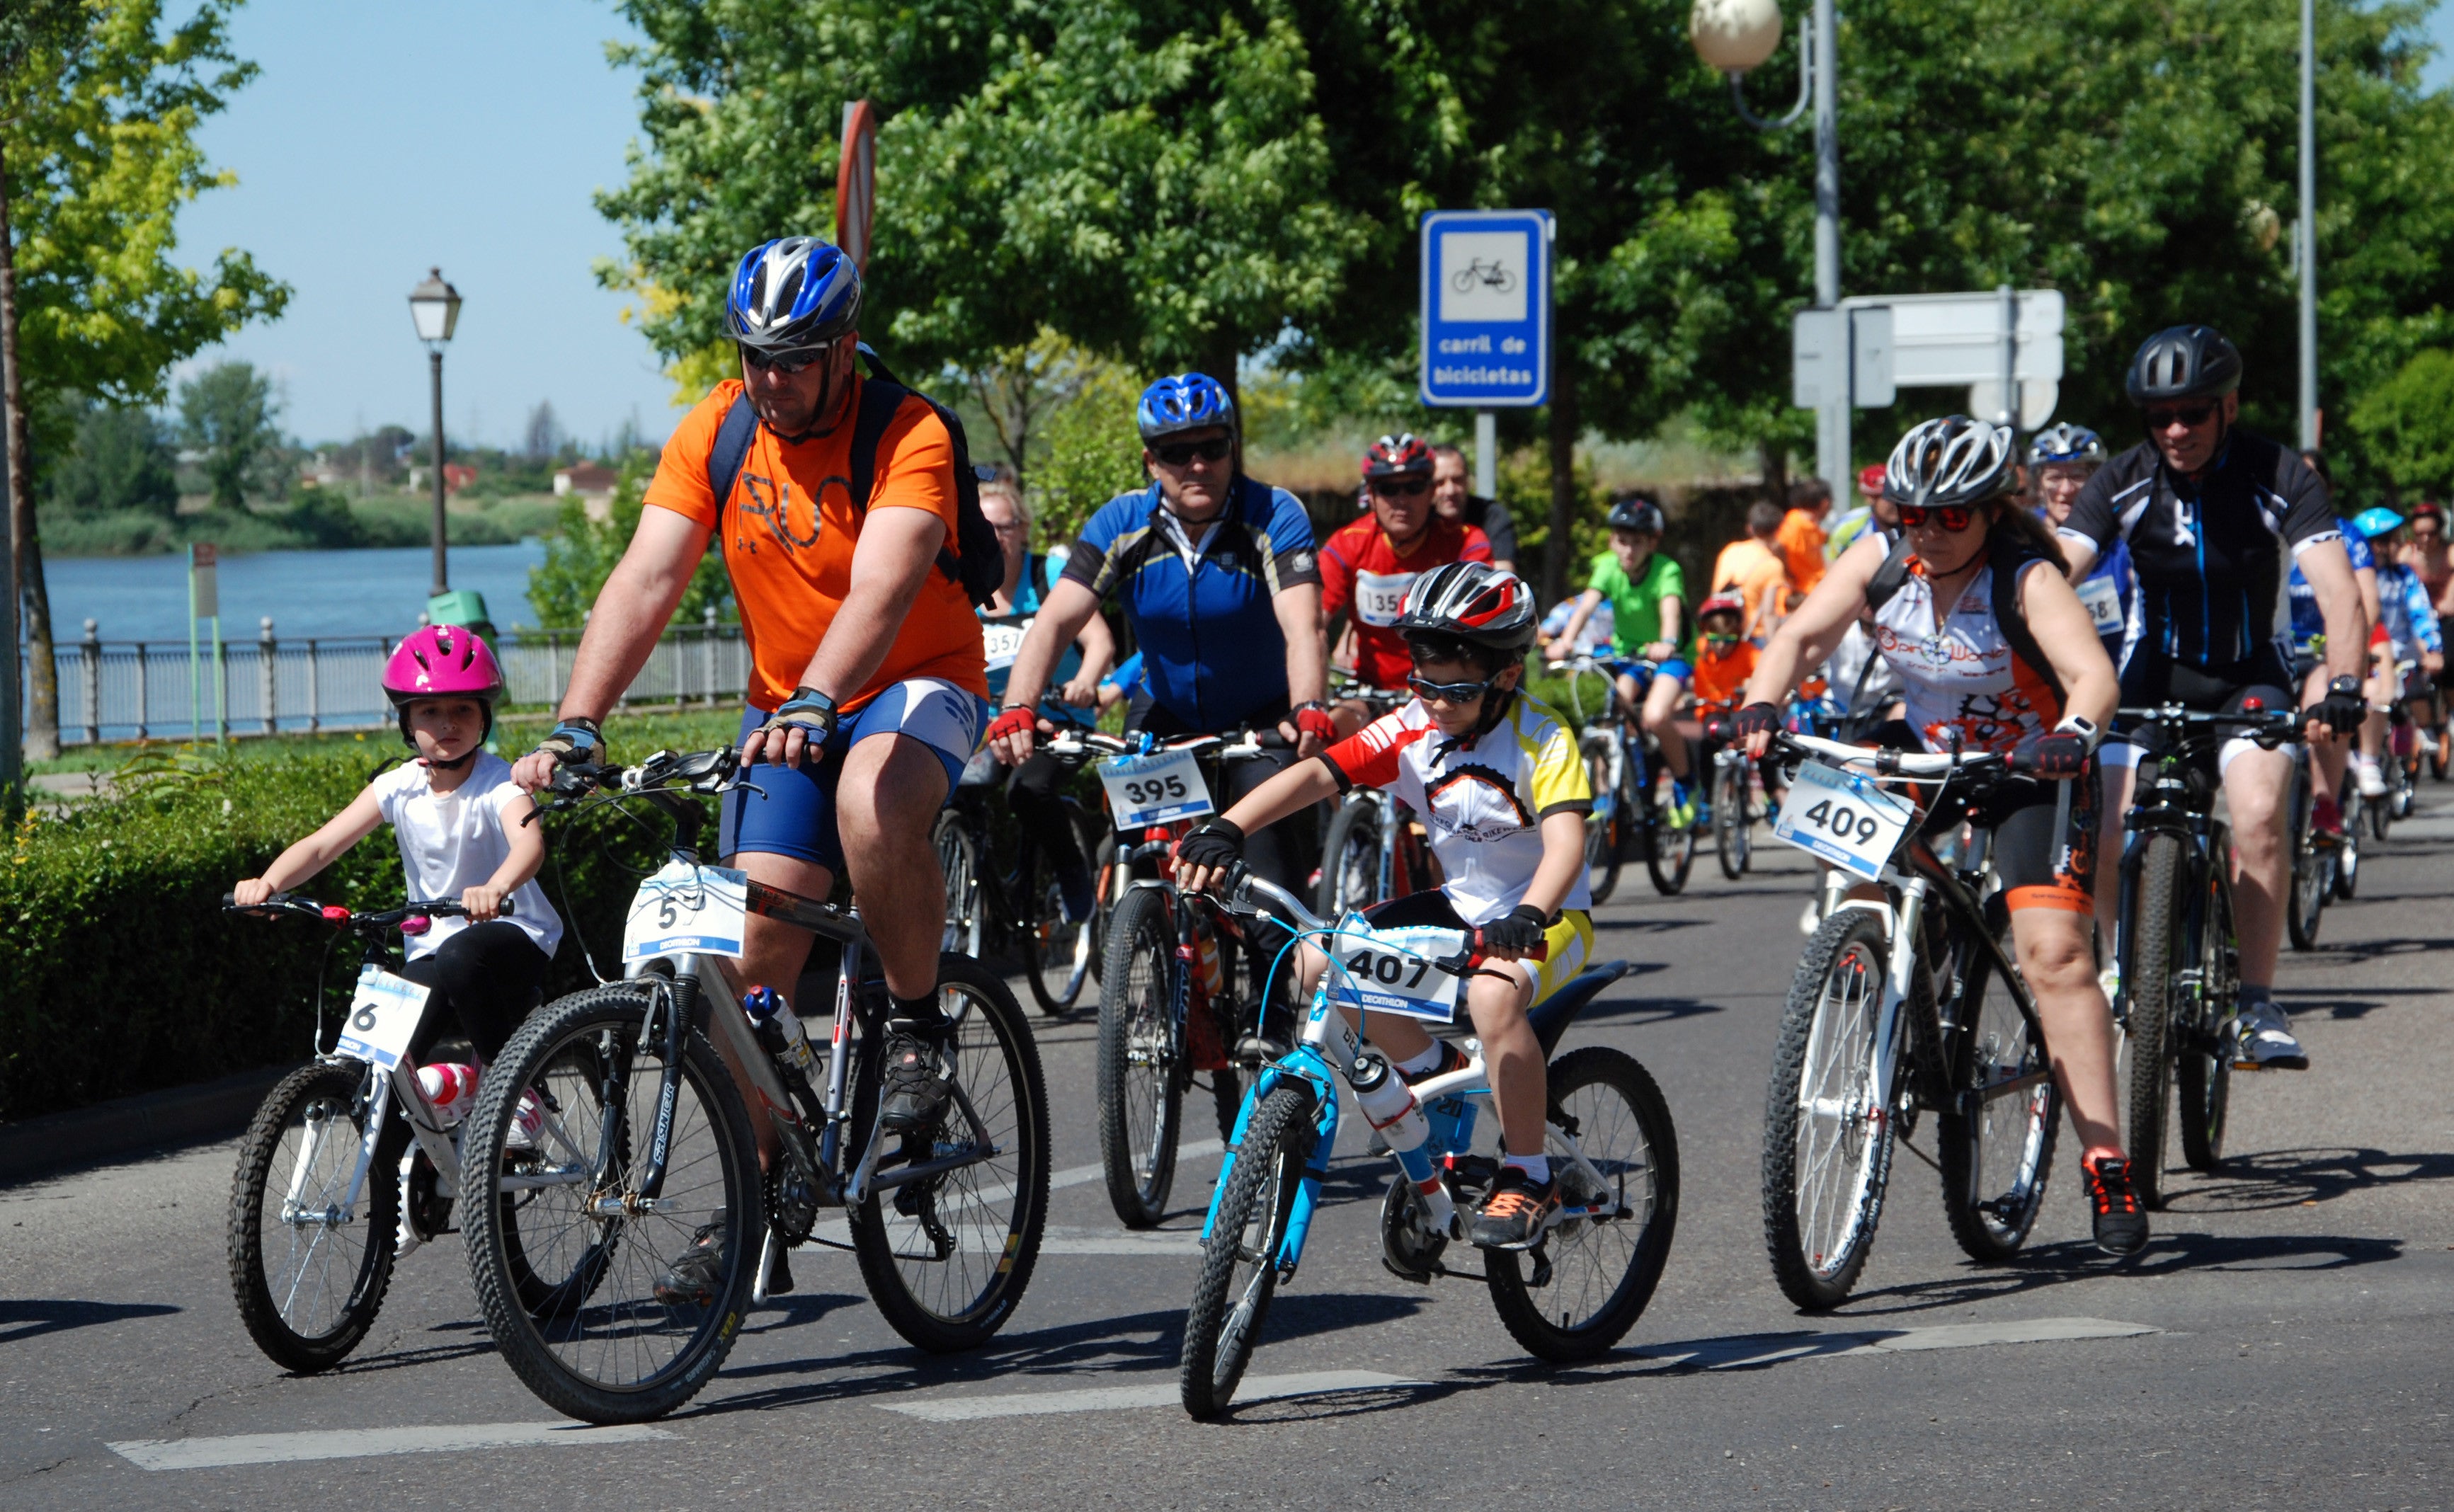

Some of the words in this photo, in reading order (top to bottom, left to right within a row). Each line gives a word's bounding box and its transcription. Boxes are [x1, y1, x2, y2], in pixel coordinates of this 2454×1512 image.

[1439, 335, 1492, 353] carril
[1501, 336, 1526, 353] de
[1434, 366, 1532, 385] bicicletas
[991, 633, 1020, 653] 357
[1125, 774, 1187, 805] 395
[1805, 800, 1878, 846] 409
[1346, 950, 1430, 989] 407
[1362, 993, 1408, 1009] DECATHLON
[351, 1002, 379, 1032] 6
